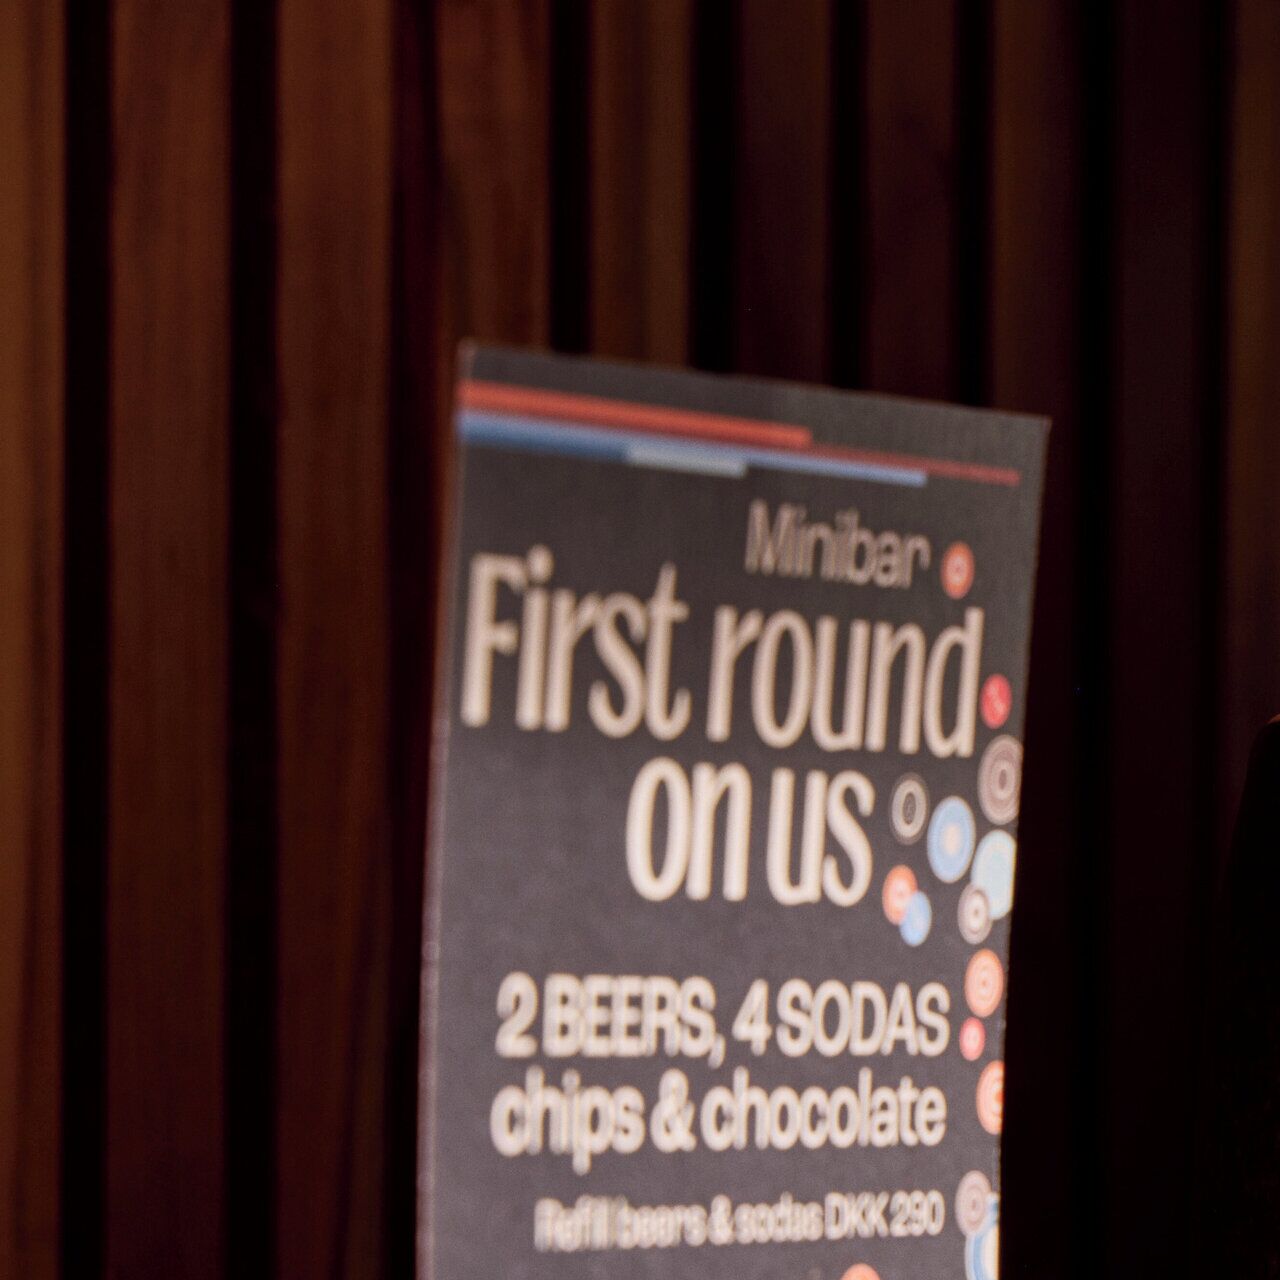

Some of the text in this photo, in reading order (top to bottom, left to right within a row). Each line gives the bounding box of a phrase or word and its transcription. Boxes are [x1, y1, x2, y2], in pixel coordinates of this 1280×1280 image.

[745, 501, 931, 589] Minibar
[460, 545, 985, 759] First round
[625, 757, 875, 907] on us
[495, 972, 950, 1068] 2 BEERS, 4 SODAS
[489, 1064, 947, 1175] chips & chocolate
[707, 1194, 735, 1246] &
[734, 1192, 823, 1245] sodas
[824, 1192, 889, 1240] DKK
[889, 1189, 946, 1237] 290
